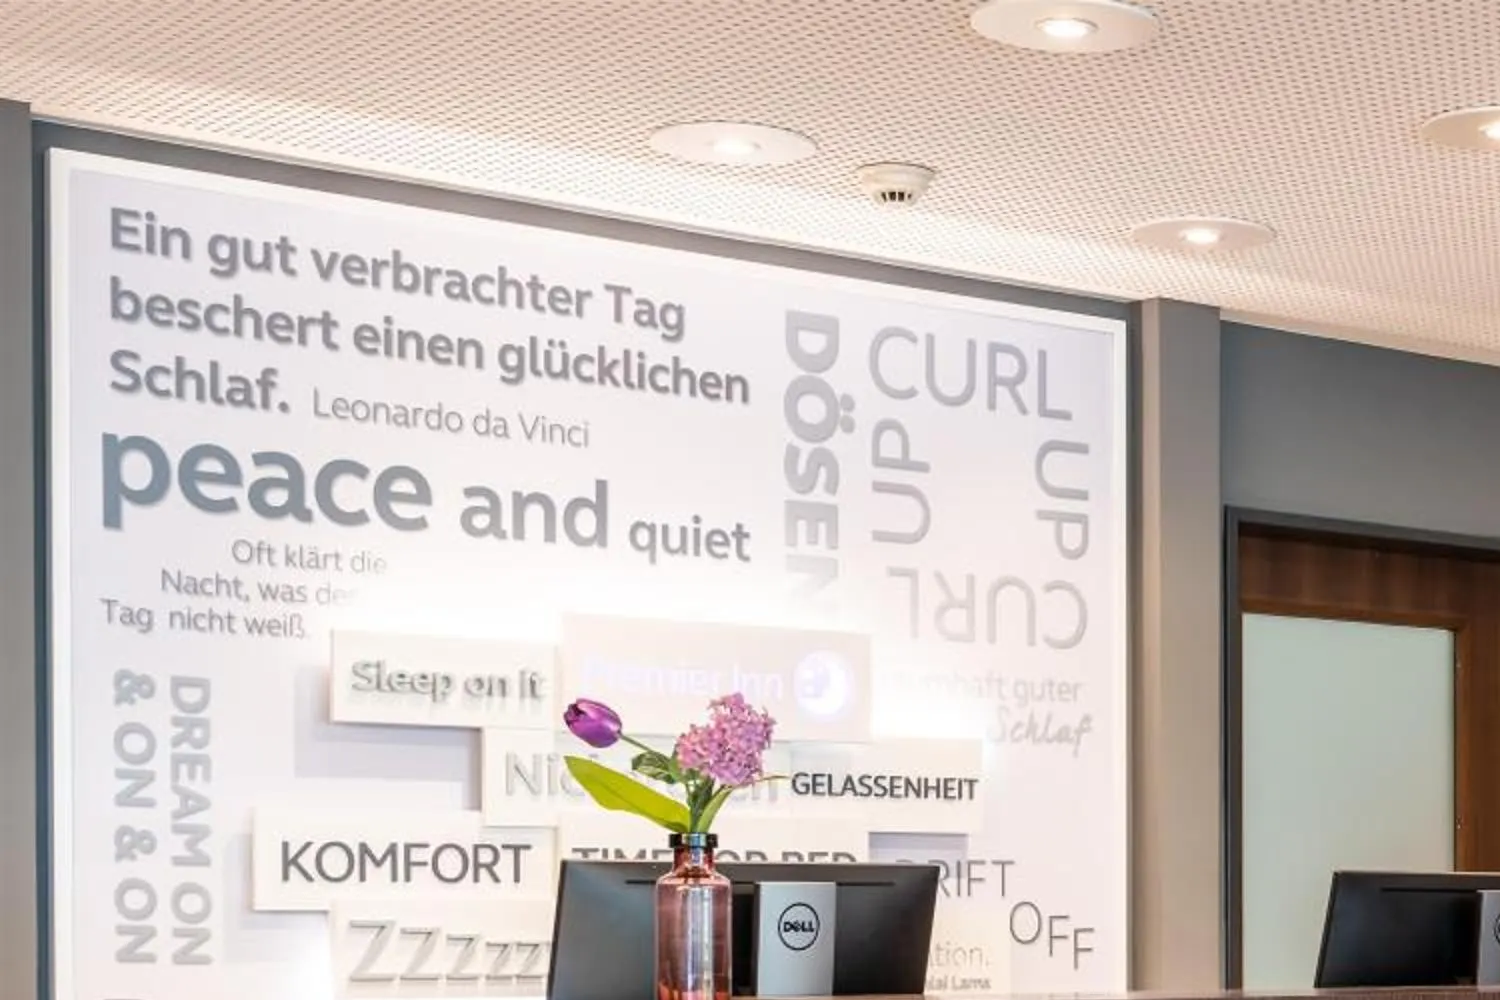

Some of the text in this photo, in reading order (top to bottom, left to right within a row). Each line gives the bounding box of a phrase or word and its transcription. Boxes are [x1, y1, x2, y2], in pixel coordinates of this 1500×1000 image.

[110, 206, 685, 343] Ein gut verbrachter Tag
[110, 276, 750, 404] beschert einen glücklichen
[869, 326, 1072, 421] CURL
[109, 349, 590, 448] Schlaf. Leonardo da Vinci
[102, 432, 751, 565] peace and quiet
[871, 417, 931, 545] UP
[1034, 438, 1090, 560] UP
[160, 568, 250, 602] Nacht,
[257, 581, 308, 603] was
[232, 539, 387, 575] Oft klärt die
[100, 598, 154, 634] Tag
[168, 606, 237, 634] nicht
[887, 566, 1088, 650] CURL
[352, 660, 452, 704] Sleep
[464, 673, 510, 700] on
[584, 653, 721, 696] Premier
[1013, 677, 1086, 708] guter
[113, 668, 156, 964] & ON & ON
[170, 674, 212, 965] DREAM ON
[791, 772, 979, 800] GELASSENHEIT
[281, 841, 531, 883] KOMFORT
[896, 858, 1015, 898] RIFT
[783, 919, 815, 933] DELL
[1010, 901, 1095, 970] OFF
